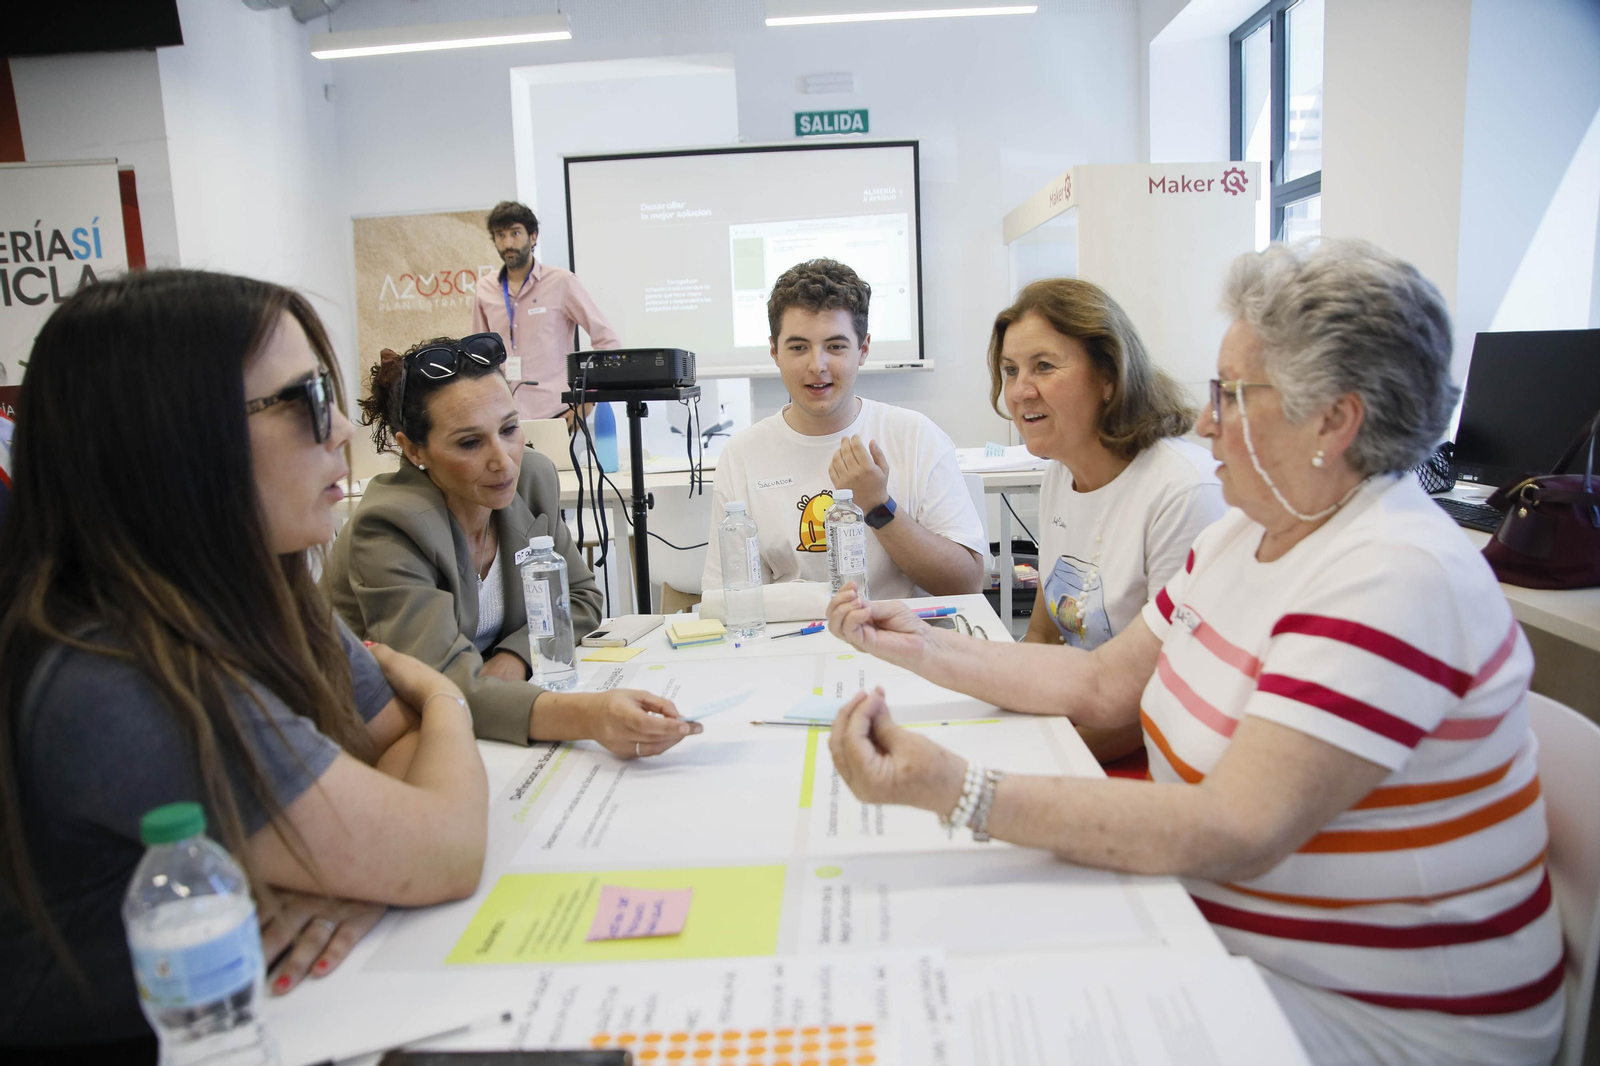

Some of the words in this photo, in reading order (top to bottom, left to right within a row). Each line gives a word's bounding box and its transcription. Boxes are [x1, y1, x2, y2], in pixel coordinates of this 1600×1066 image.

[800, 113, 864, 133] SALIDA
[1149, 175, 1215, 194] Maker
[1049, 187, 1063, 208] Maker
[650, 210, 675, 221] mejor
[379, 300, 411, 311] PLAN
[758, 478, 793, 488] SALVADOR
